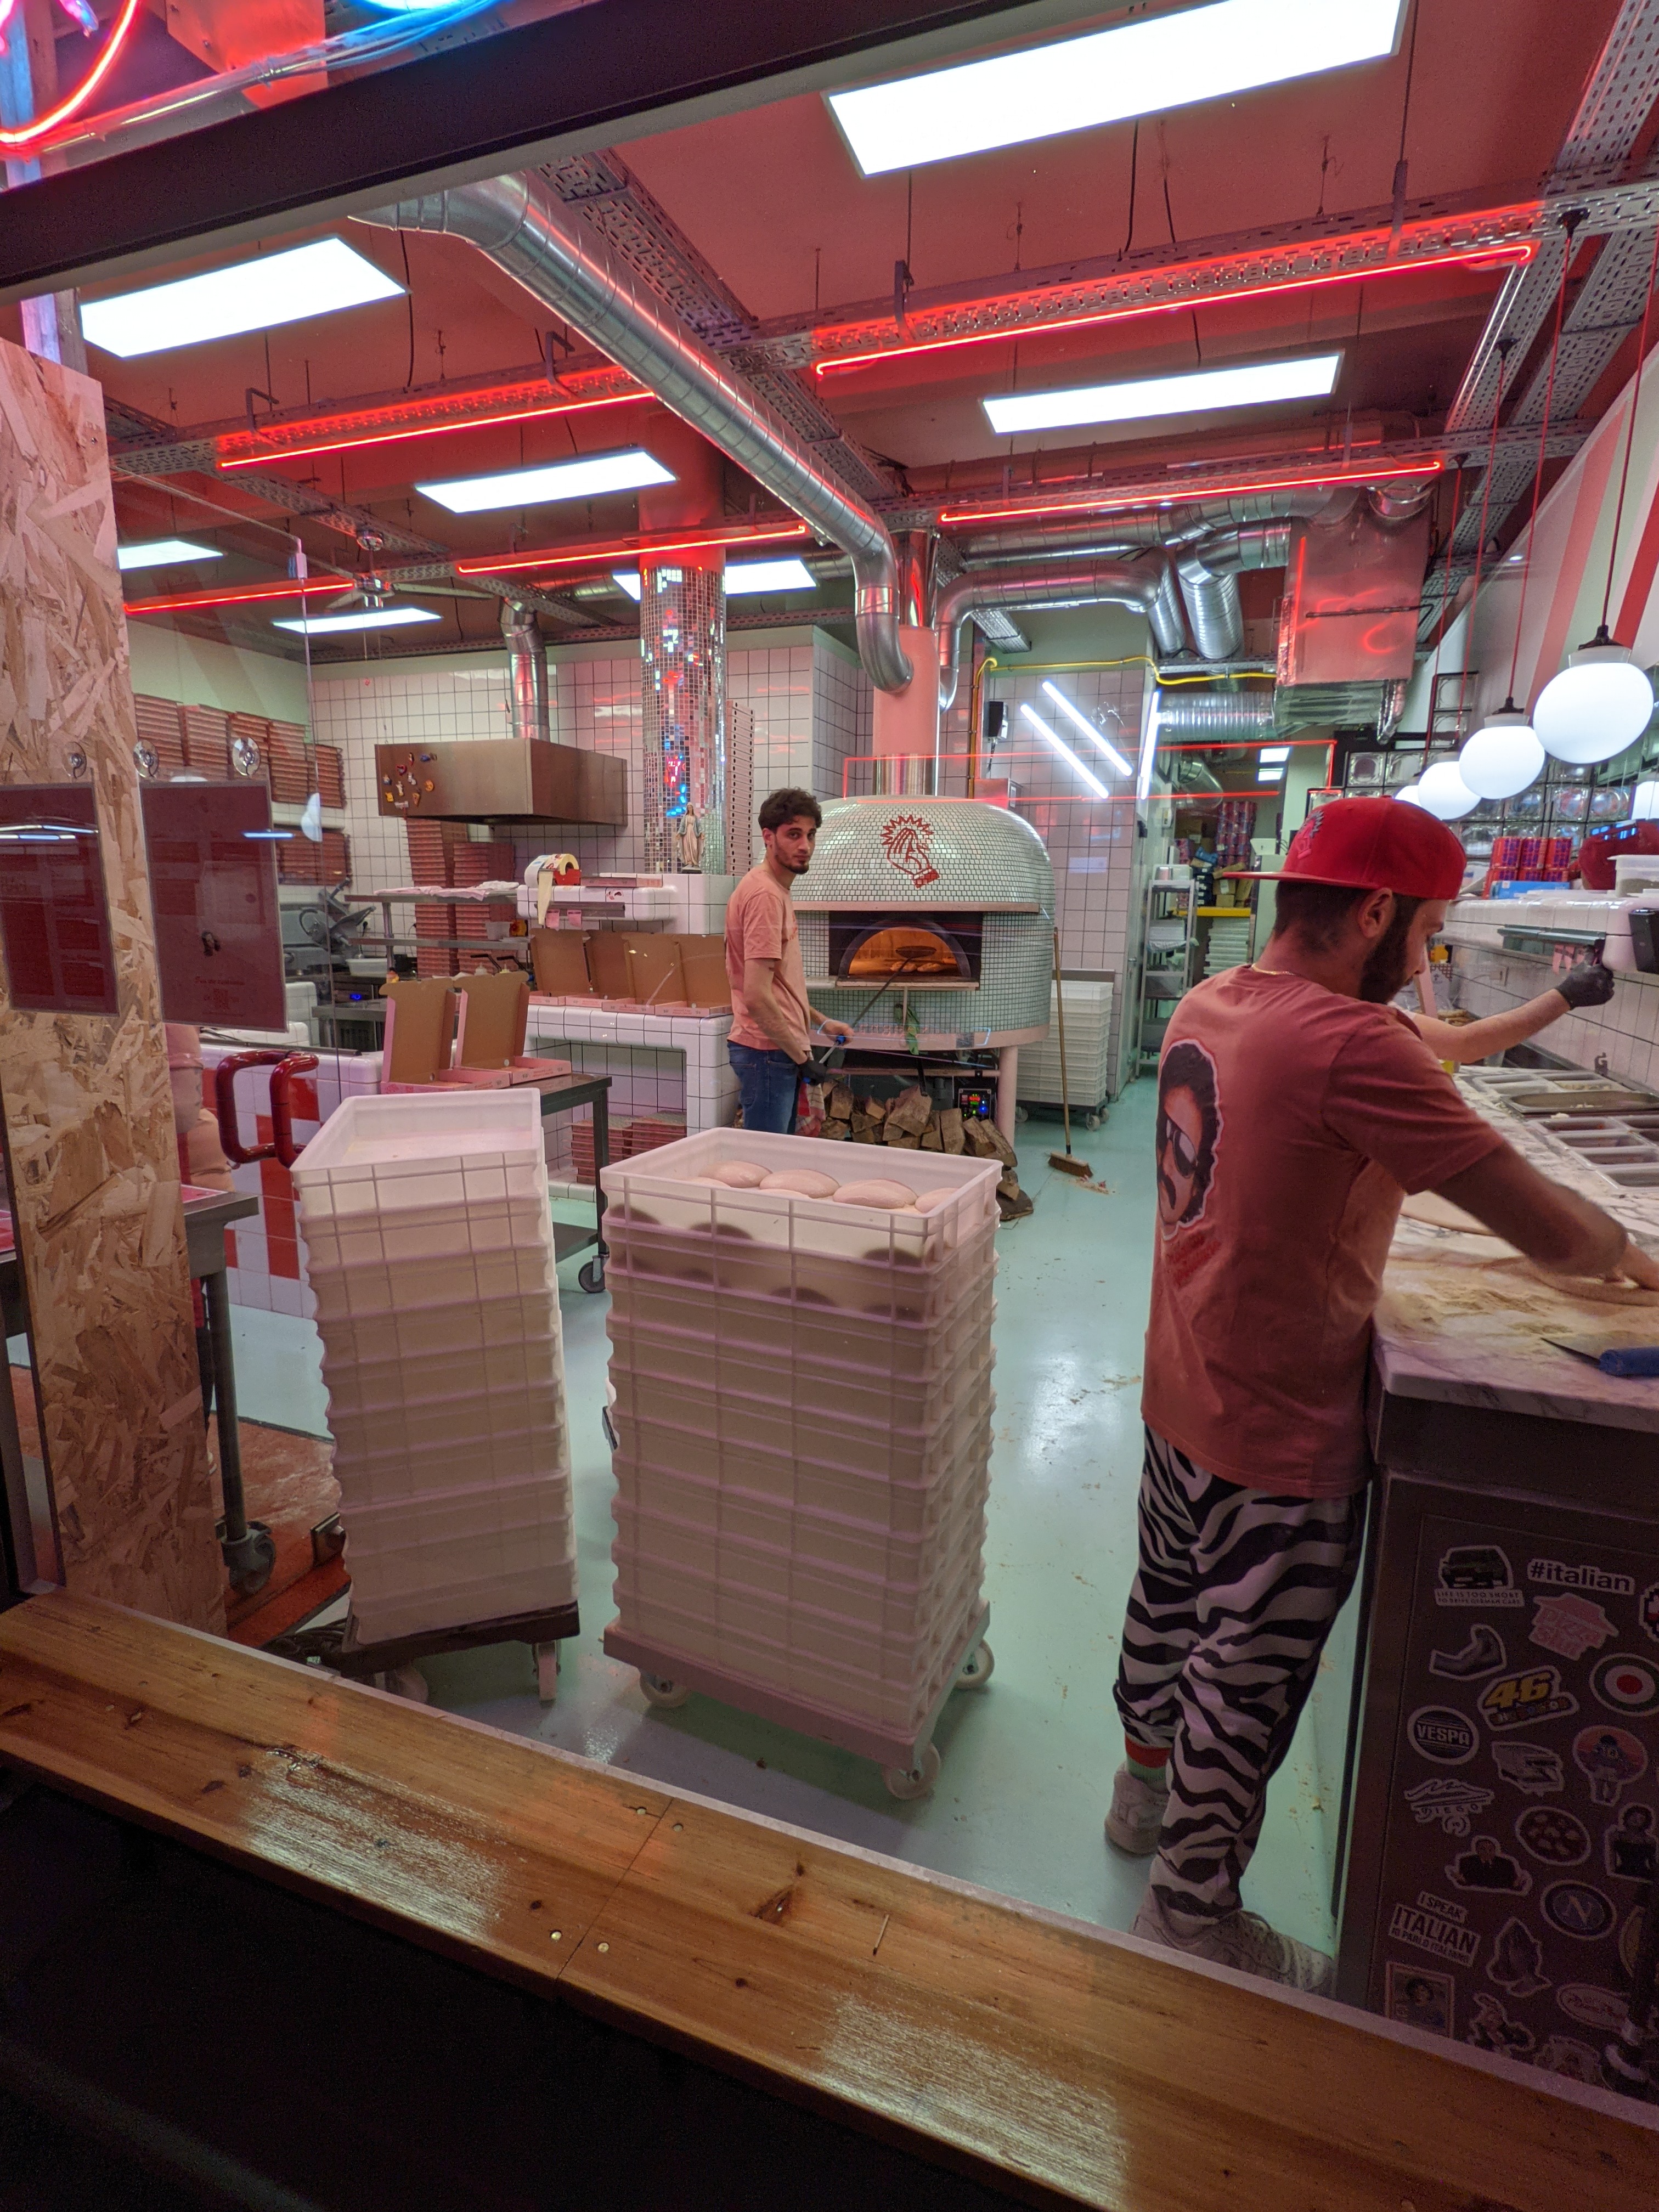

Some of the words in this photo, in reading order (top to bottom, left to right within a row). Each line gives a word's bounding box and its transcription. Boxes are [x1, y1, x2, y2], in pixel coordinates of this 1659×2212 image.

[1530, 1561, 1630, 1592] #italian
[1483, 1672, 1552, 1709] 46
[1416, 1723, 1470, 1746] VESPA
[1420, 1894, 1425, 1904] I
[1426, 1897, 1463, 1918] SPEAK
[1393, 1906, 1476, 1954] ITALIAN
